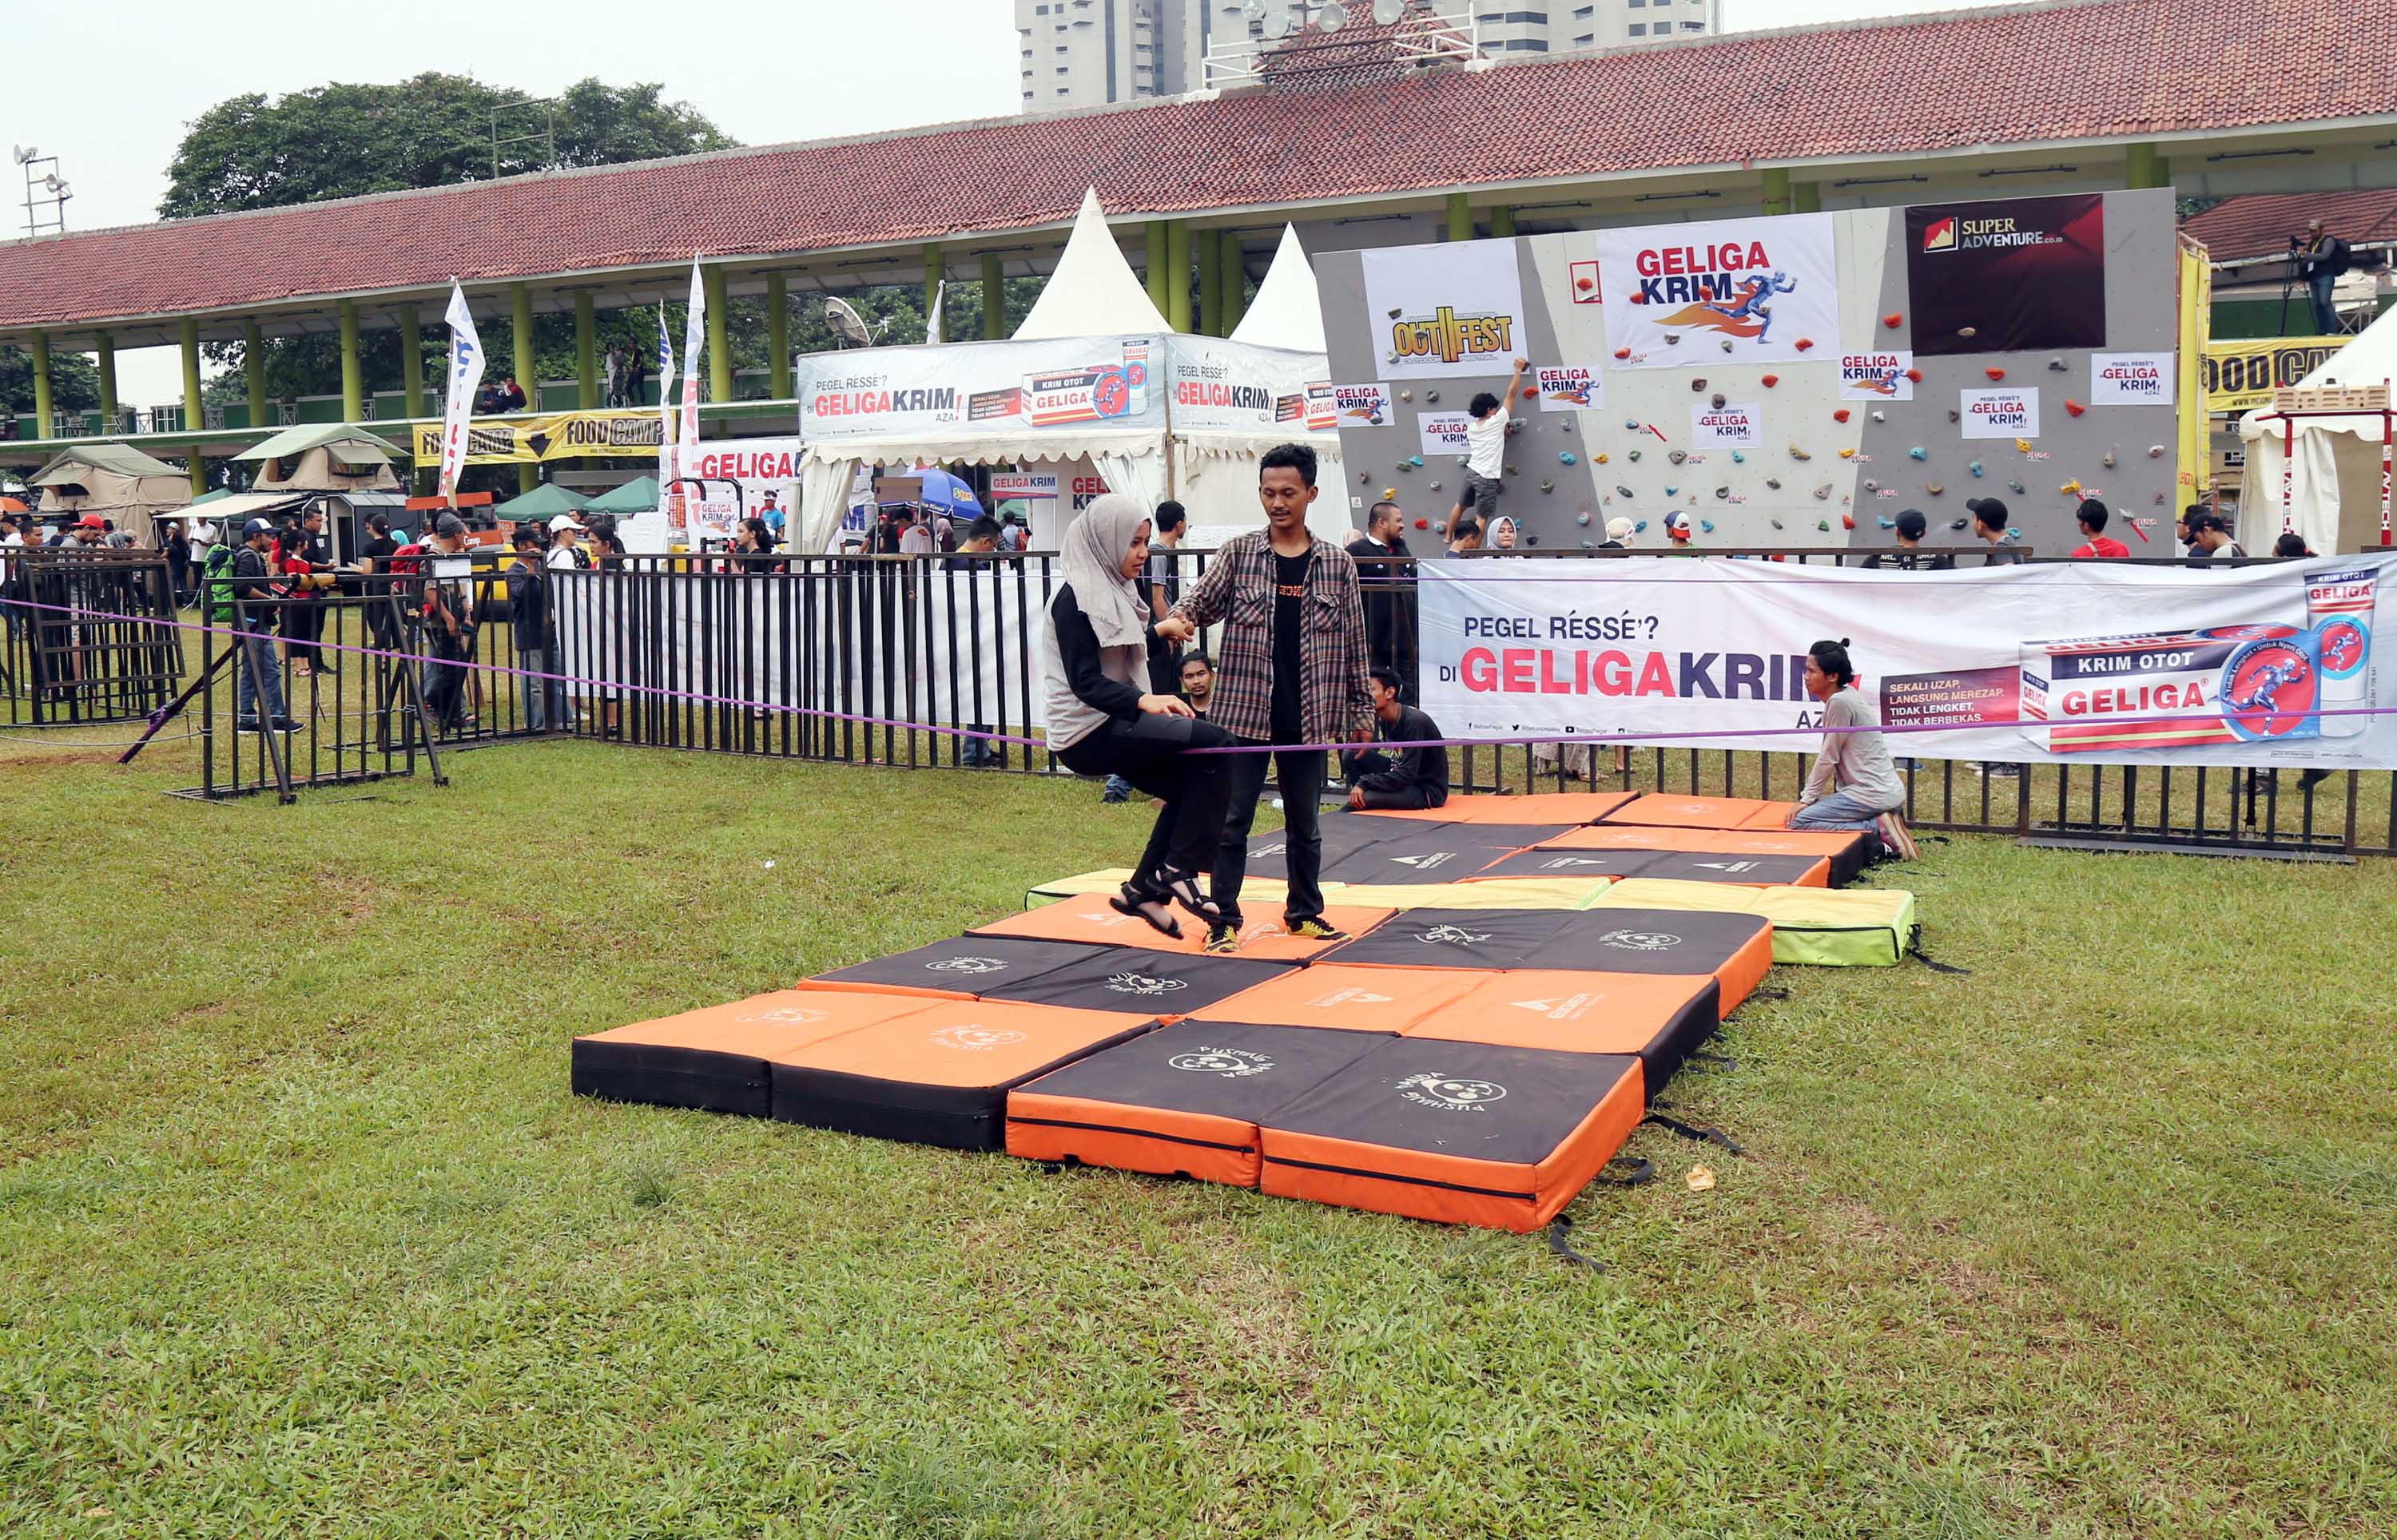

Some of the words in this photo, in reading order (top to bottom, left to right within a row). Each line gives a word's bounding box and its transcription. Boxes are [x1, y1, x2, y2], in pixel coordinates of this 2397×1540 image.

[1962, 217, 2016, 235] SUPER
[1636, 241, 1770, 277] GELIGA
[1640, 273, 1732, 305] KRIM
[1842, 355, 1898, 367] GELIGA
[1178, 365, 1198, 377] PEGEL
[1540, 370, 1590, 382] GELIGA
[1843, 367, 1882, 379] KRIM
[2103, 368, 2159, 379] GELIGA
[817, 379, 844, 391] PEGEL
[1042, 379, 1062, 389] KRIM
[1063, 377, 1084, 387] OTOT
[1542, 380, 1576, 391] KRIM
[2121, 380, 2156, 390] KRIM
[1336, 387, 1379, 399] GELIGA
[1036, 392, 1088, 409] GELIGA
[1338, 399, 1369, 409] KRIM
[1311, 402, 1335, 414] GELIGA
[1972, 403, 2025, 414] GELIGA
[1701, 415, 1748, 426] GELIGA
[1989, 414, 2023, 424] KRIM
[567, 420, 609, 446] FOOD
[612, 419, 663, 445] CAMP
[1428, 423, 1468, 433] GELIGA
[1716, 427, 1747, 436] KRIM
[1442, 434, 1469, 443] KRIM
[1071, 477, 1107, 494] GEL
[2381, 470, 2391, 530] AVTECH
[702, 503, 732, 513] GELIGA
[702, 512, 723, 522] KRIM
[2310, 585, 2371, 600] GELIGA
[1465, 616, 1540, 639] PEGEL
[2078, 656, 2131, 673] KRIM
[2139, 651, 2194, 669] OTOT
[2226, 671, 2235, 693] Tidak
[2232, 649, 2254, 673] Lengket
[2257, 641, 2277, 651] Untuk
[2278, 641, 2296, 652] Nyeri
[2296, 647, 2308, 661] Otot
[1440, 665, 1457, 682] DI
[1890, 682, 1927, 693] SEKALI
[1890, 693, 1948, 705] LANGSUNG
[2062, 682, 2204, 716] GELIGA
[1890, 707, 1920, 716] TIDAK
[1796, 710, 1823, 728] AZ
[1890, 718, 1921, 727] TIDAK
[1401, 1091, 1485, 1112] PUSHING
